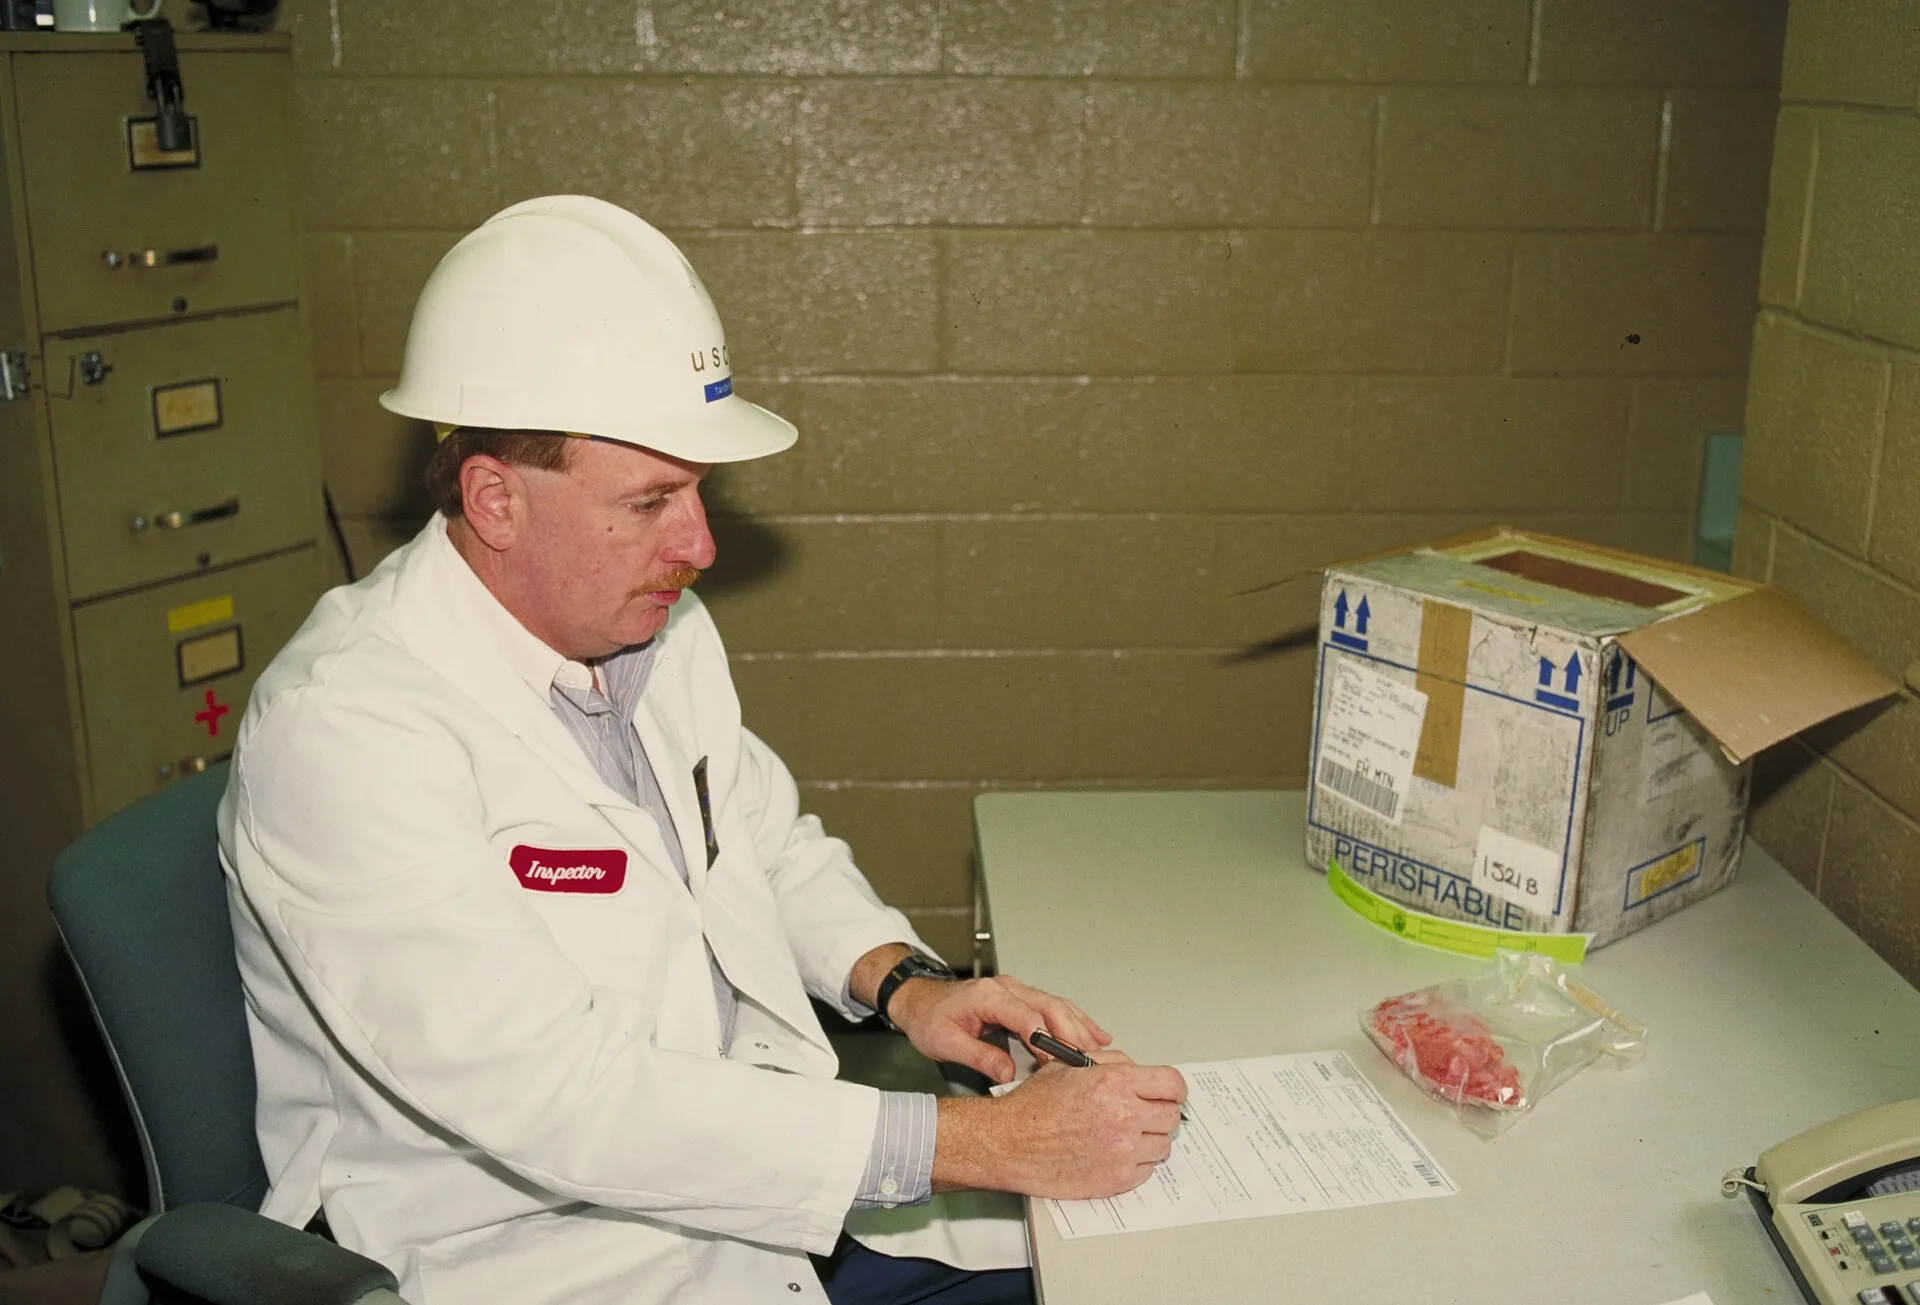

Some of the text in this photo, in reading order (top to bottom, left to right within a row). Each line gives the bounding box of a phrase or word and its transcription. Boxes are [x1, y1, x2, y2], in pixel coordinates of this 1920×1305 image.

[1606, 708, 1630, 737] UP
[525, 860, 606, 886] Inspector
[1334, 837, 1525, 932] PERISHABLE
